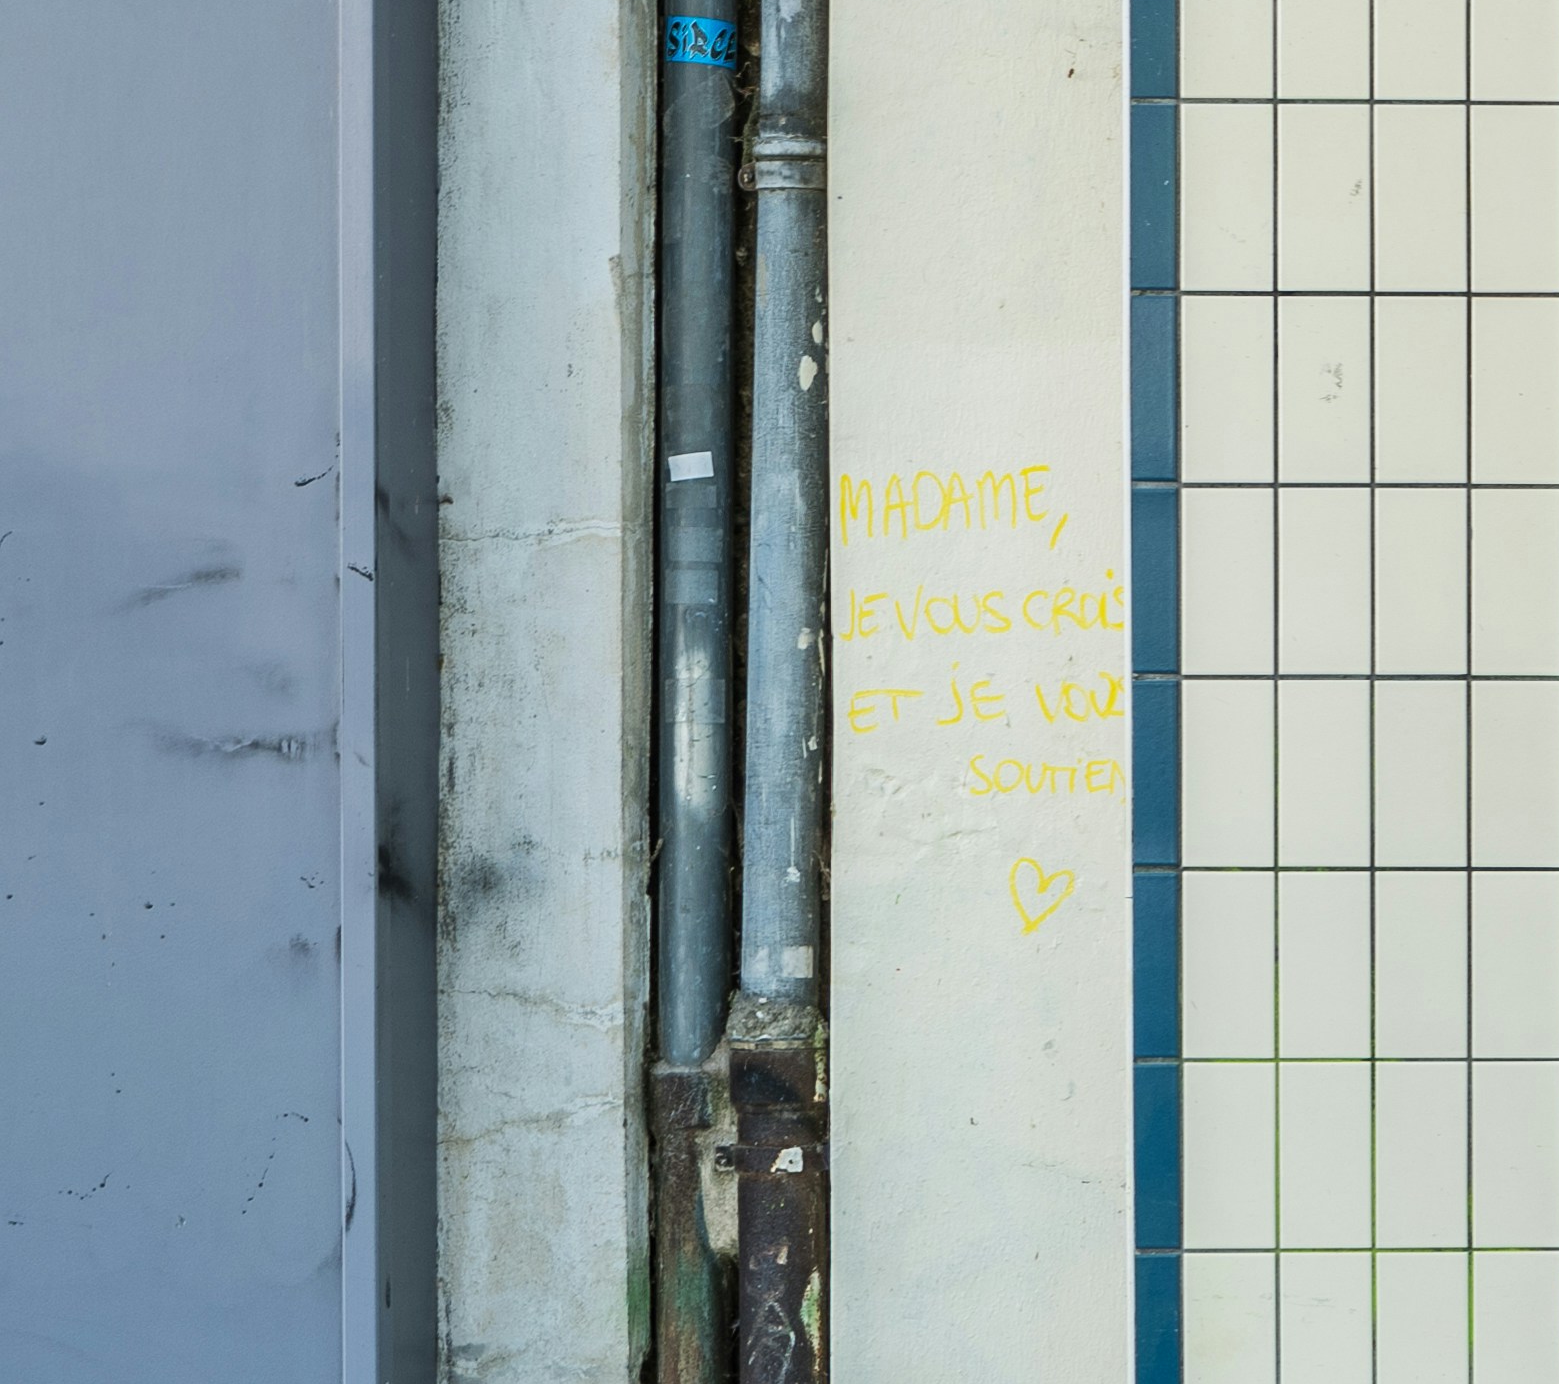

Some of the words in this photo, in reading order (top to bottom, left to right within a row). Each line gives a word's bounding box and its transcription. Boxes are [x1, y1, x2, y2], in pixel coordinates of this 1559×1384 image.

[840, 465, 1068, 550] MADAME,
[894, 584, 1012, 642] VOUS
[848, 688, 924, 735] ET
